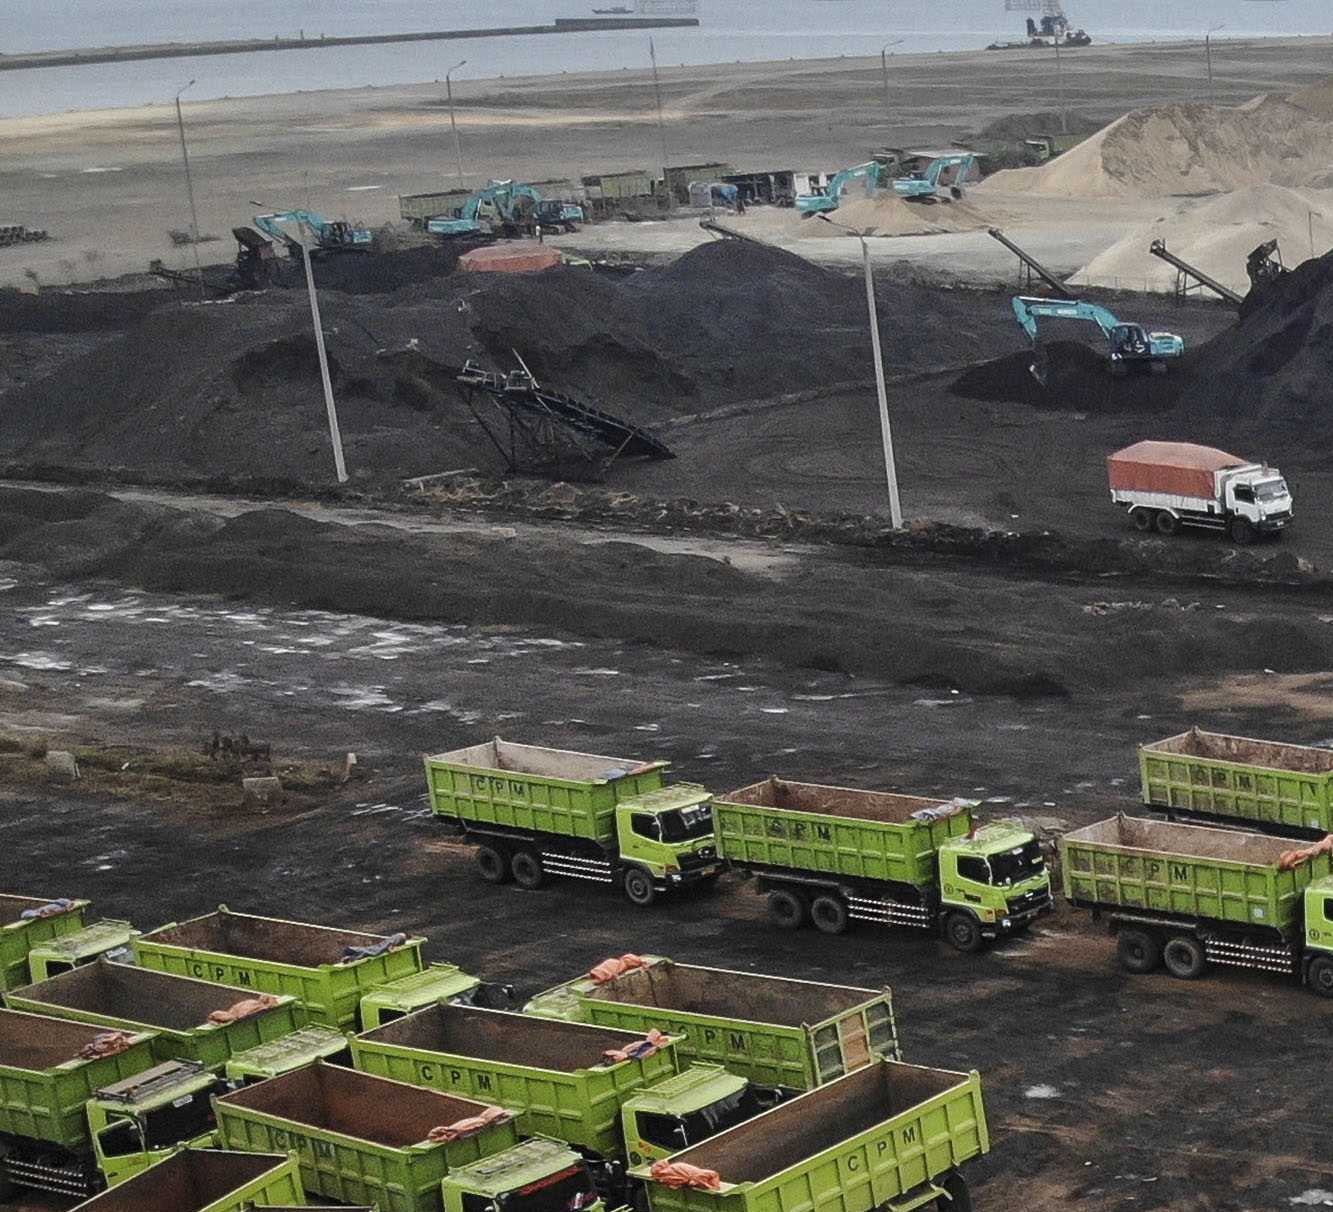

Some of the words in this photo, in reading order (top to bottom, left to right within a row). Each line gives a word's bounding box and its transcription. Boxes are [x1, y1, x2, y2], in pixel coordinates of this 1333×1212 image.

[192, 963, 251, 987] CPM
[421, 1065, 492, 1091] CPM
[847, 1126, 916, 1172] CPM
